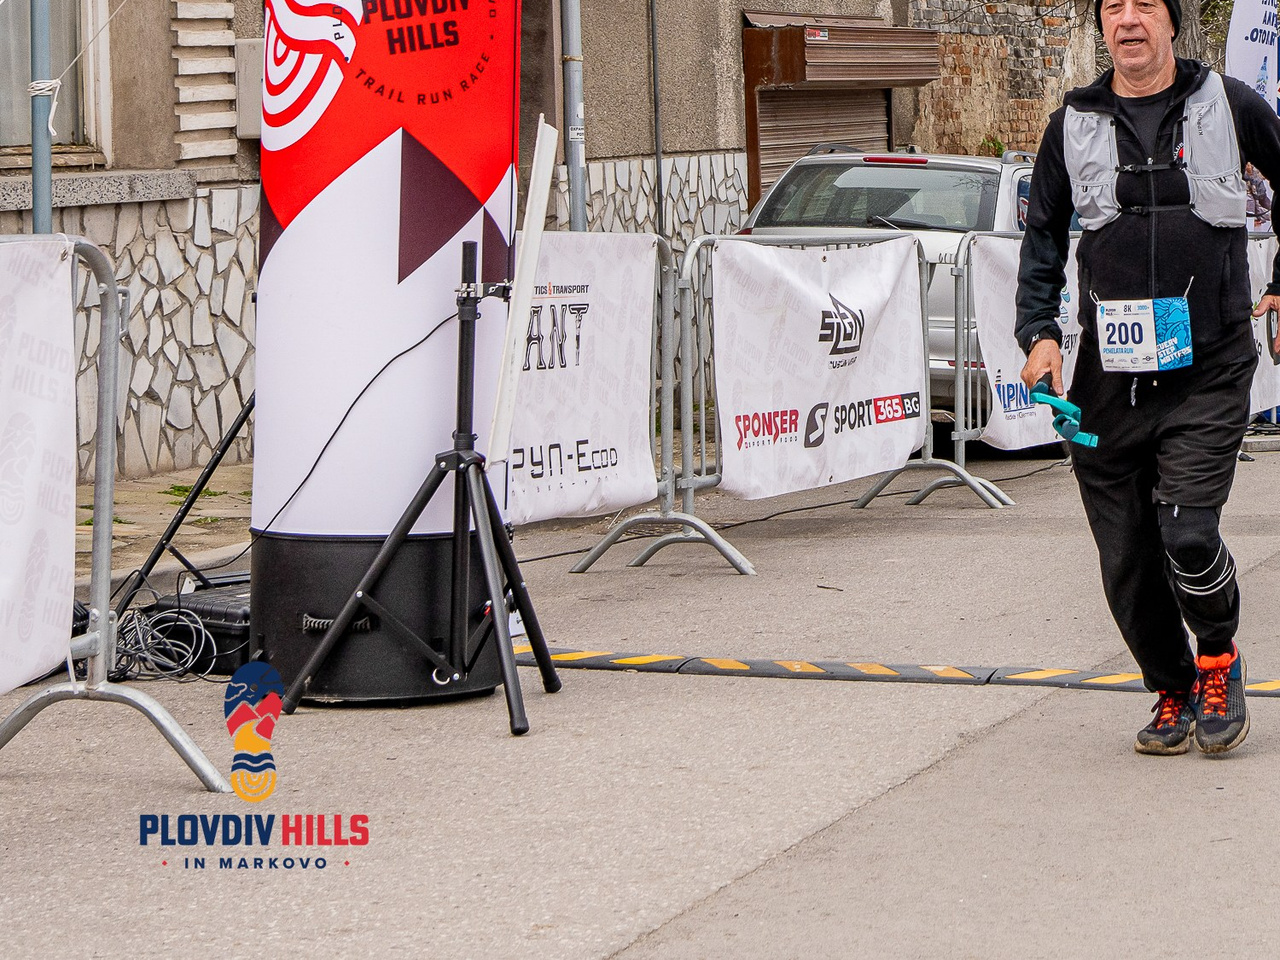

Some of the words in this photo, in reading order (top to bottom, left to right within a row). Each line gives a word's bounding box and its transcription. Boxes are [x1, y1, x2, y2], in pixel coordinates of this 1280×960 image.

[386, 20, 459, 55] HILLS
[355, 69, 405, 103] TRAIL
[417, 88, 453, 105] RUN
[460, 52, 490, 91] RACE
[1105, 321, 1144, 345] 200
[735, 409, 799, 451] SPONSER
